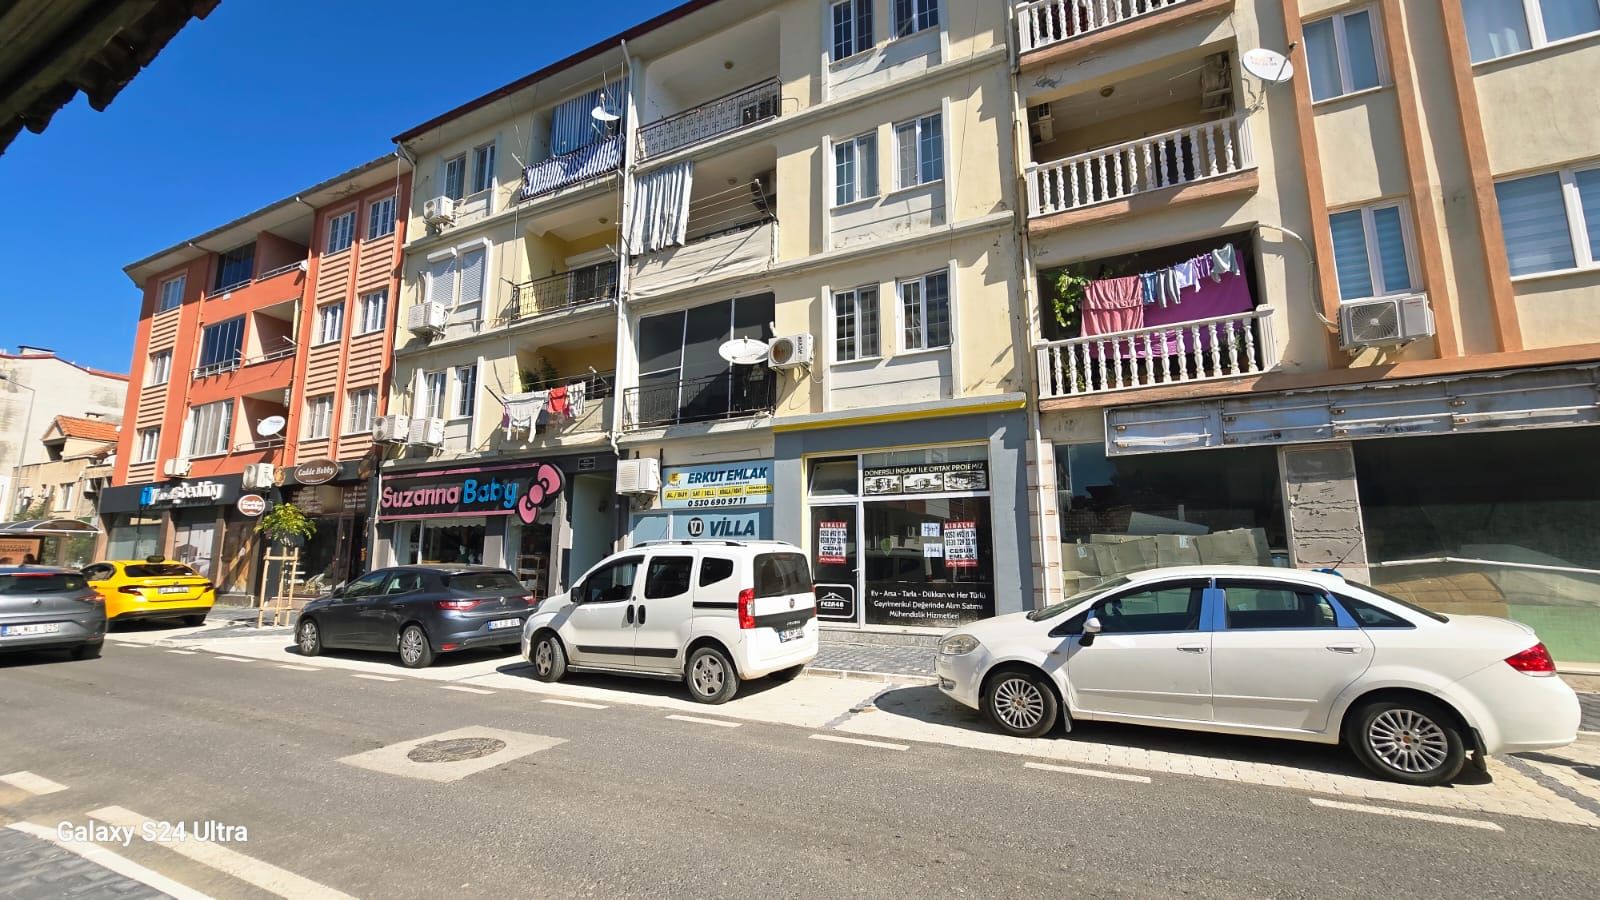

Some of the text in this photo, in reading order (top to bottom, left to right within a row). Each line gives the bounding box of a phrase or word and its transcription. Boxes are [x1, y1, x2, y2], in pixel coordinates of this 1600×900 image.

[929, 464, 950, 473] ORTAK
[687, 467, 768, 484] ERKUT EMLAK
[381, 486, 460, 508] Suzanna
[463, 478, 518, 508] Baby
[694, 499, 709, 507] 530
[711, 498, 726, 506] 690
[728, 497, 737, 505] 97
[710, 517, 755, 537] VİLLA
[957, 591, 968, 599] Her
